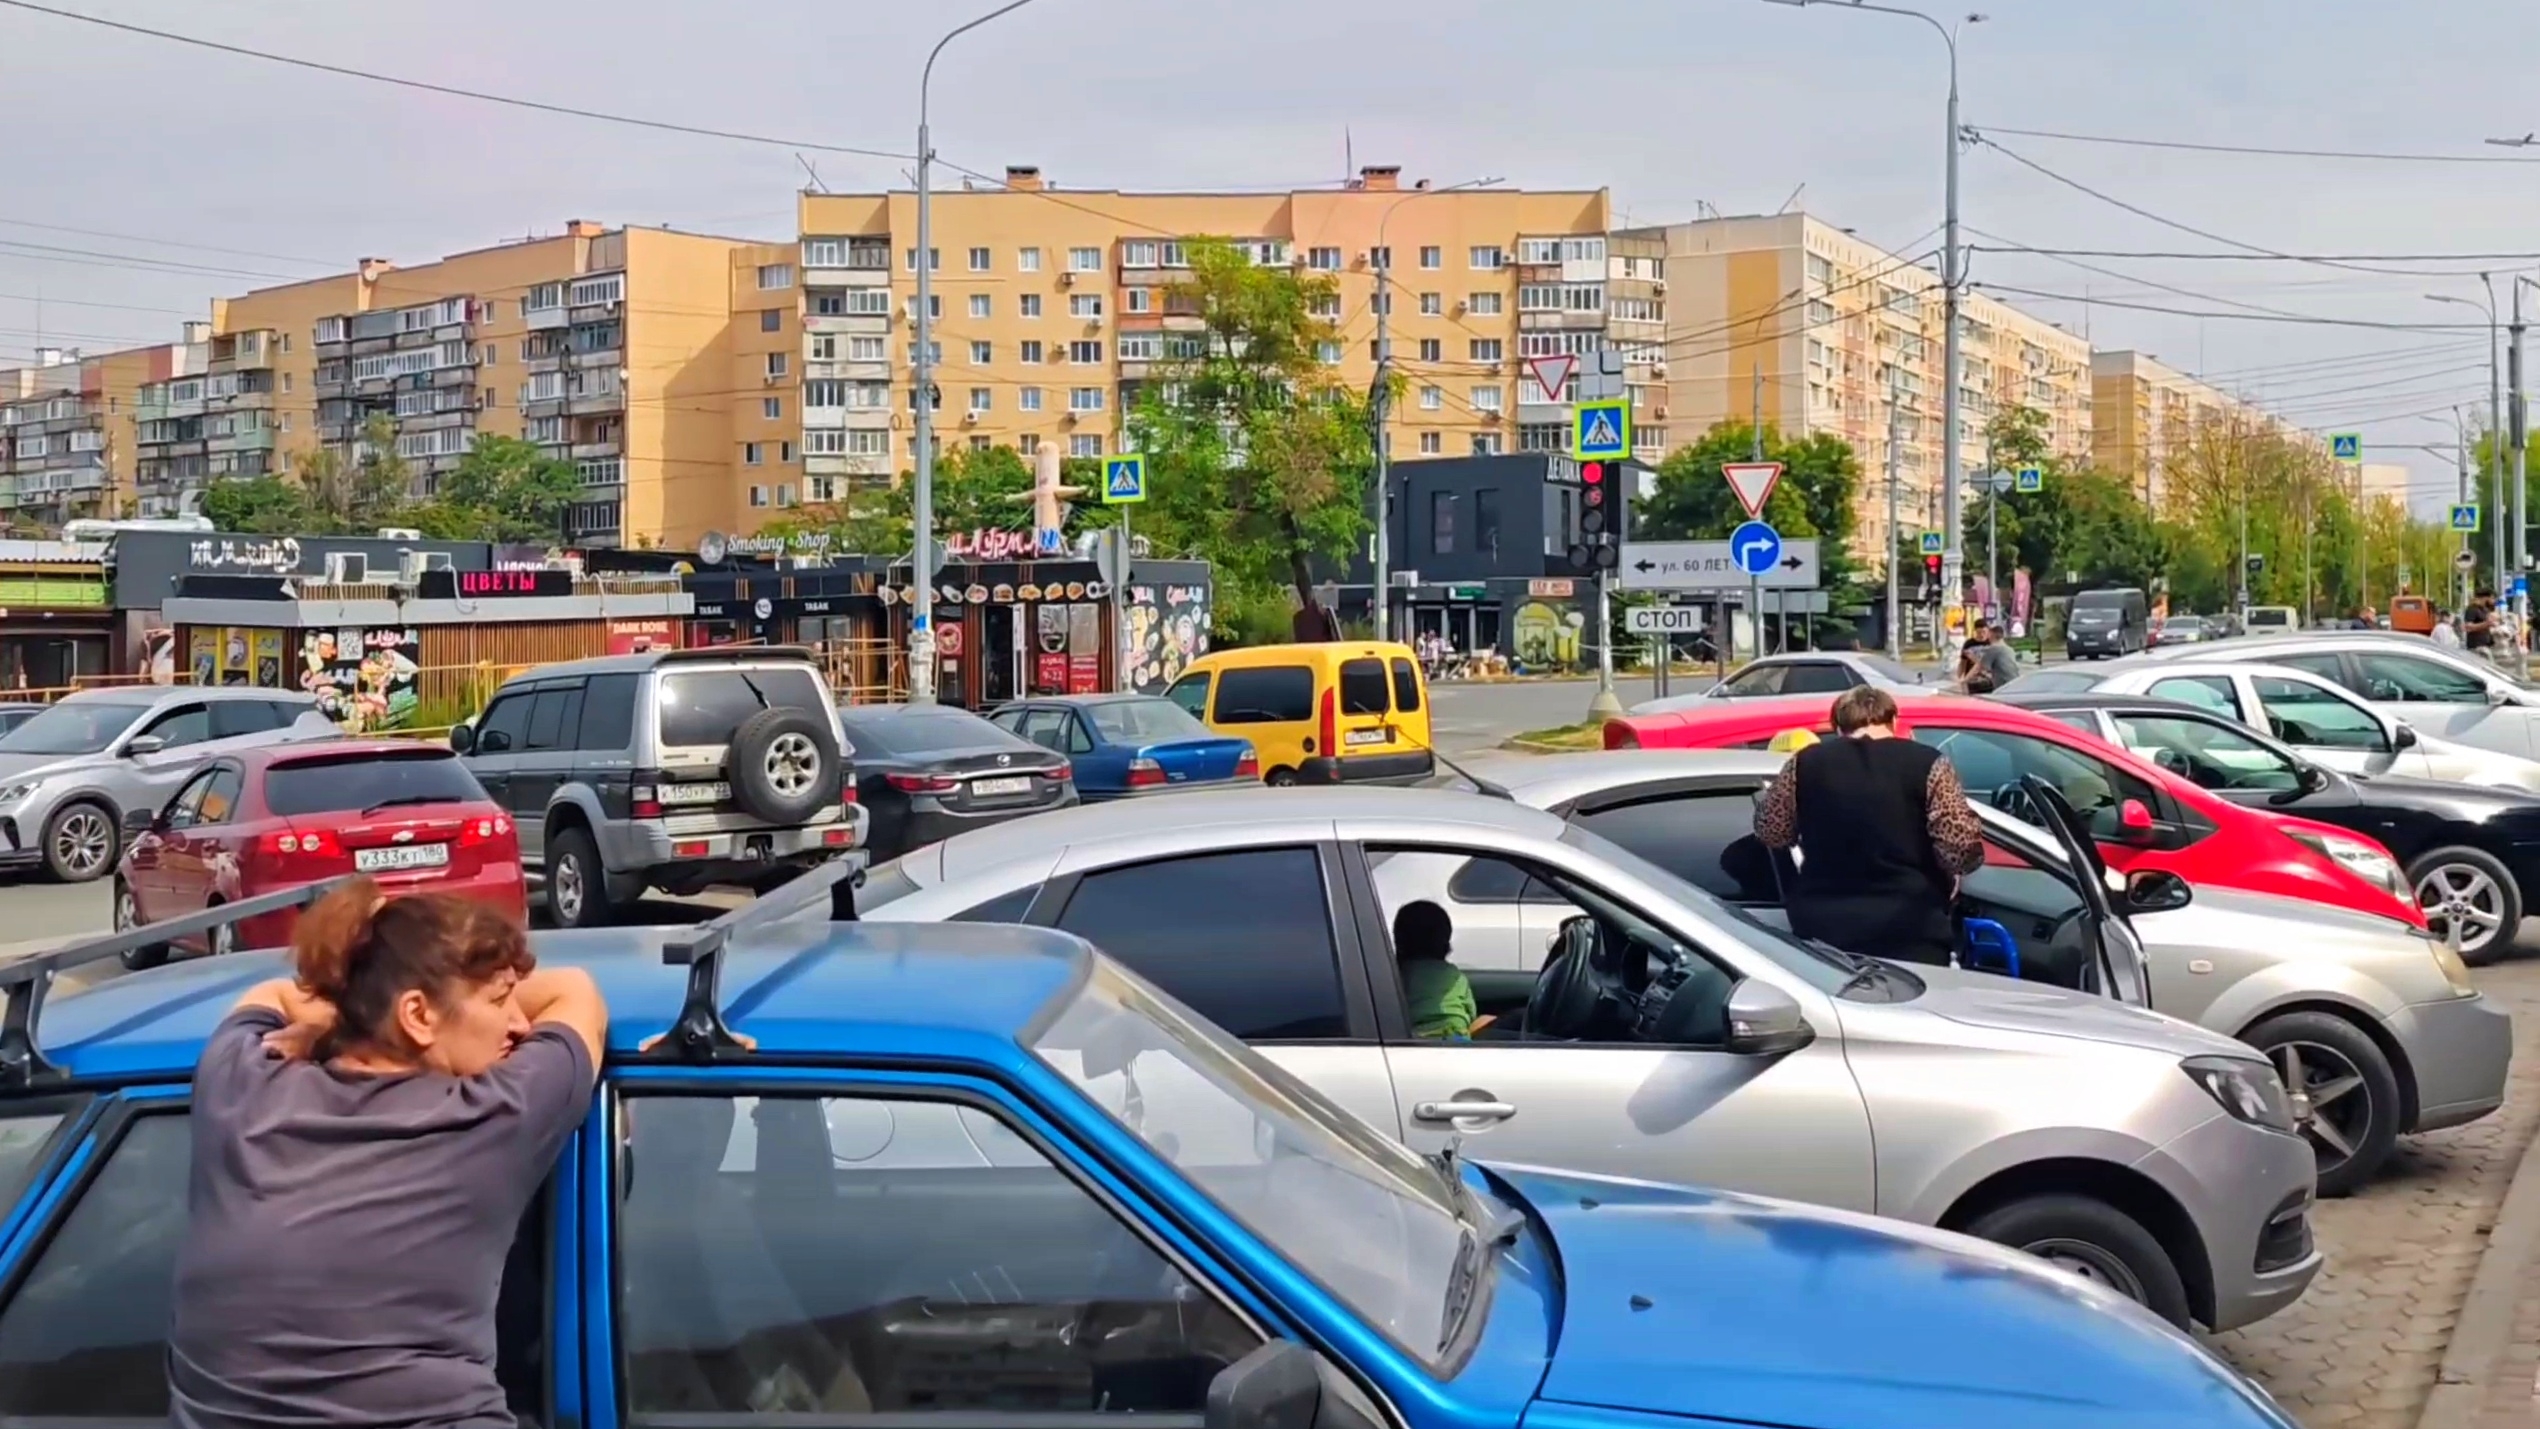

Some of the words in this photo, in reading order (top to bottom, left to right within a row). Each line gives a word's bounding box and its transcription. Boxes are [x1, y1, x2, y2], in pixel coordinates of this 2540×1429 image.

[727, 533, 785, 554] Smoking
[795, 530, 830, 555] Shop
[1661, 562, 1679, 574] ул.
[1684, 560, 1700, 571] 60
[1704, 558, 1730, 571] ЛЕТ
[463, 571, 537, 593] ЦВЕТЫ
[1636, 611, 1691, 628] СТОП
